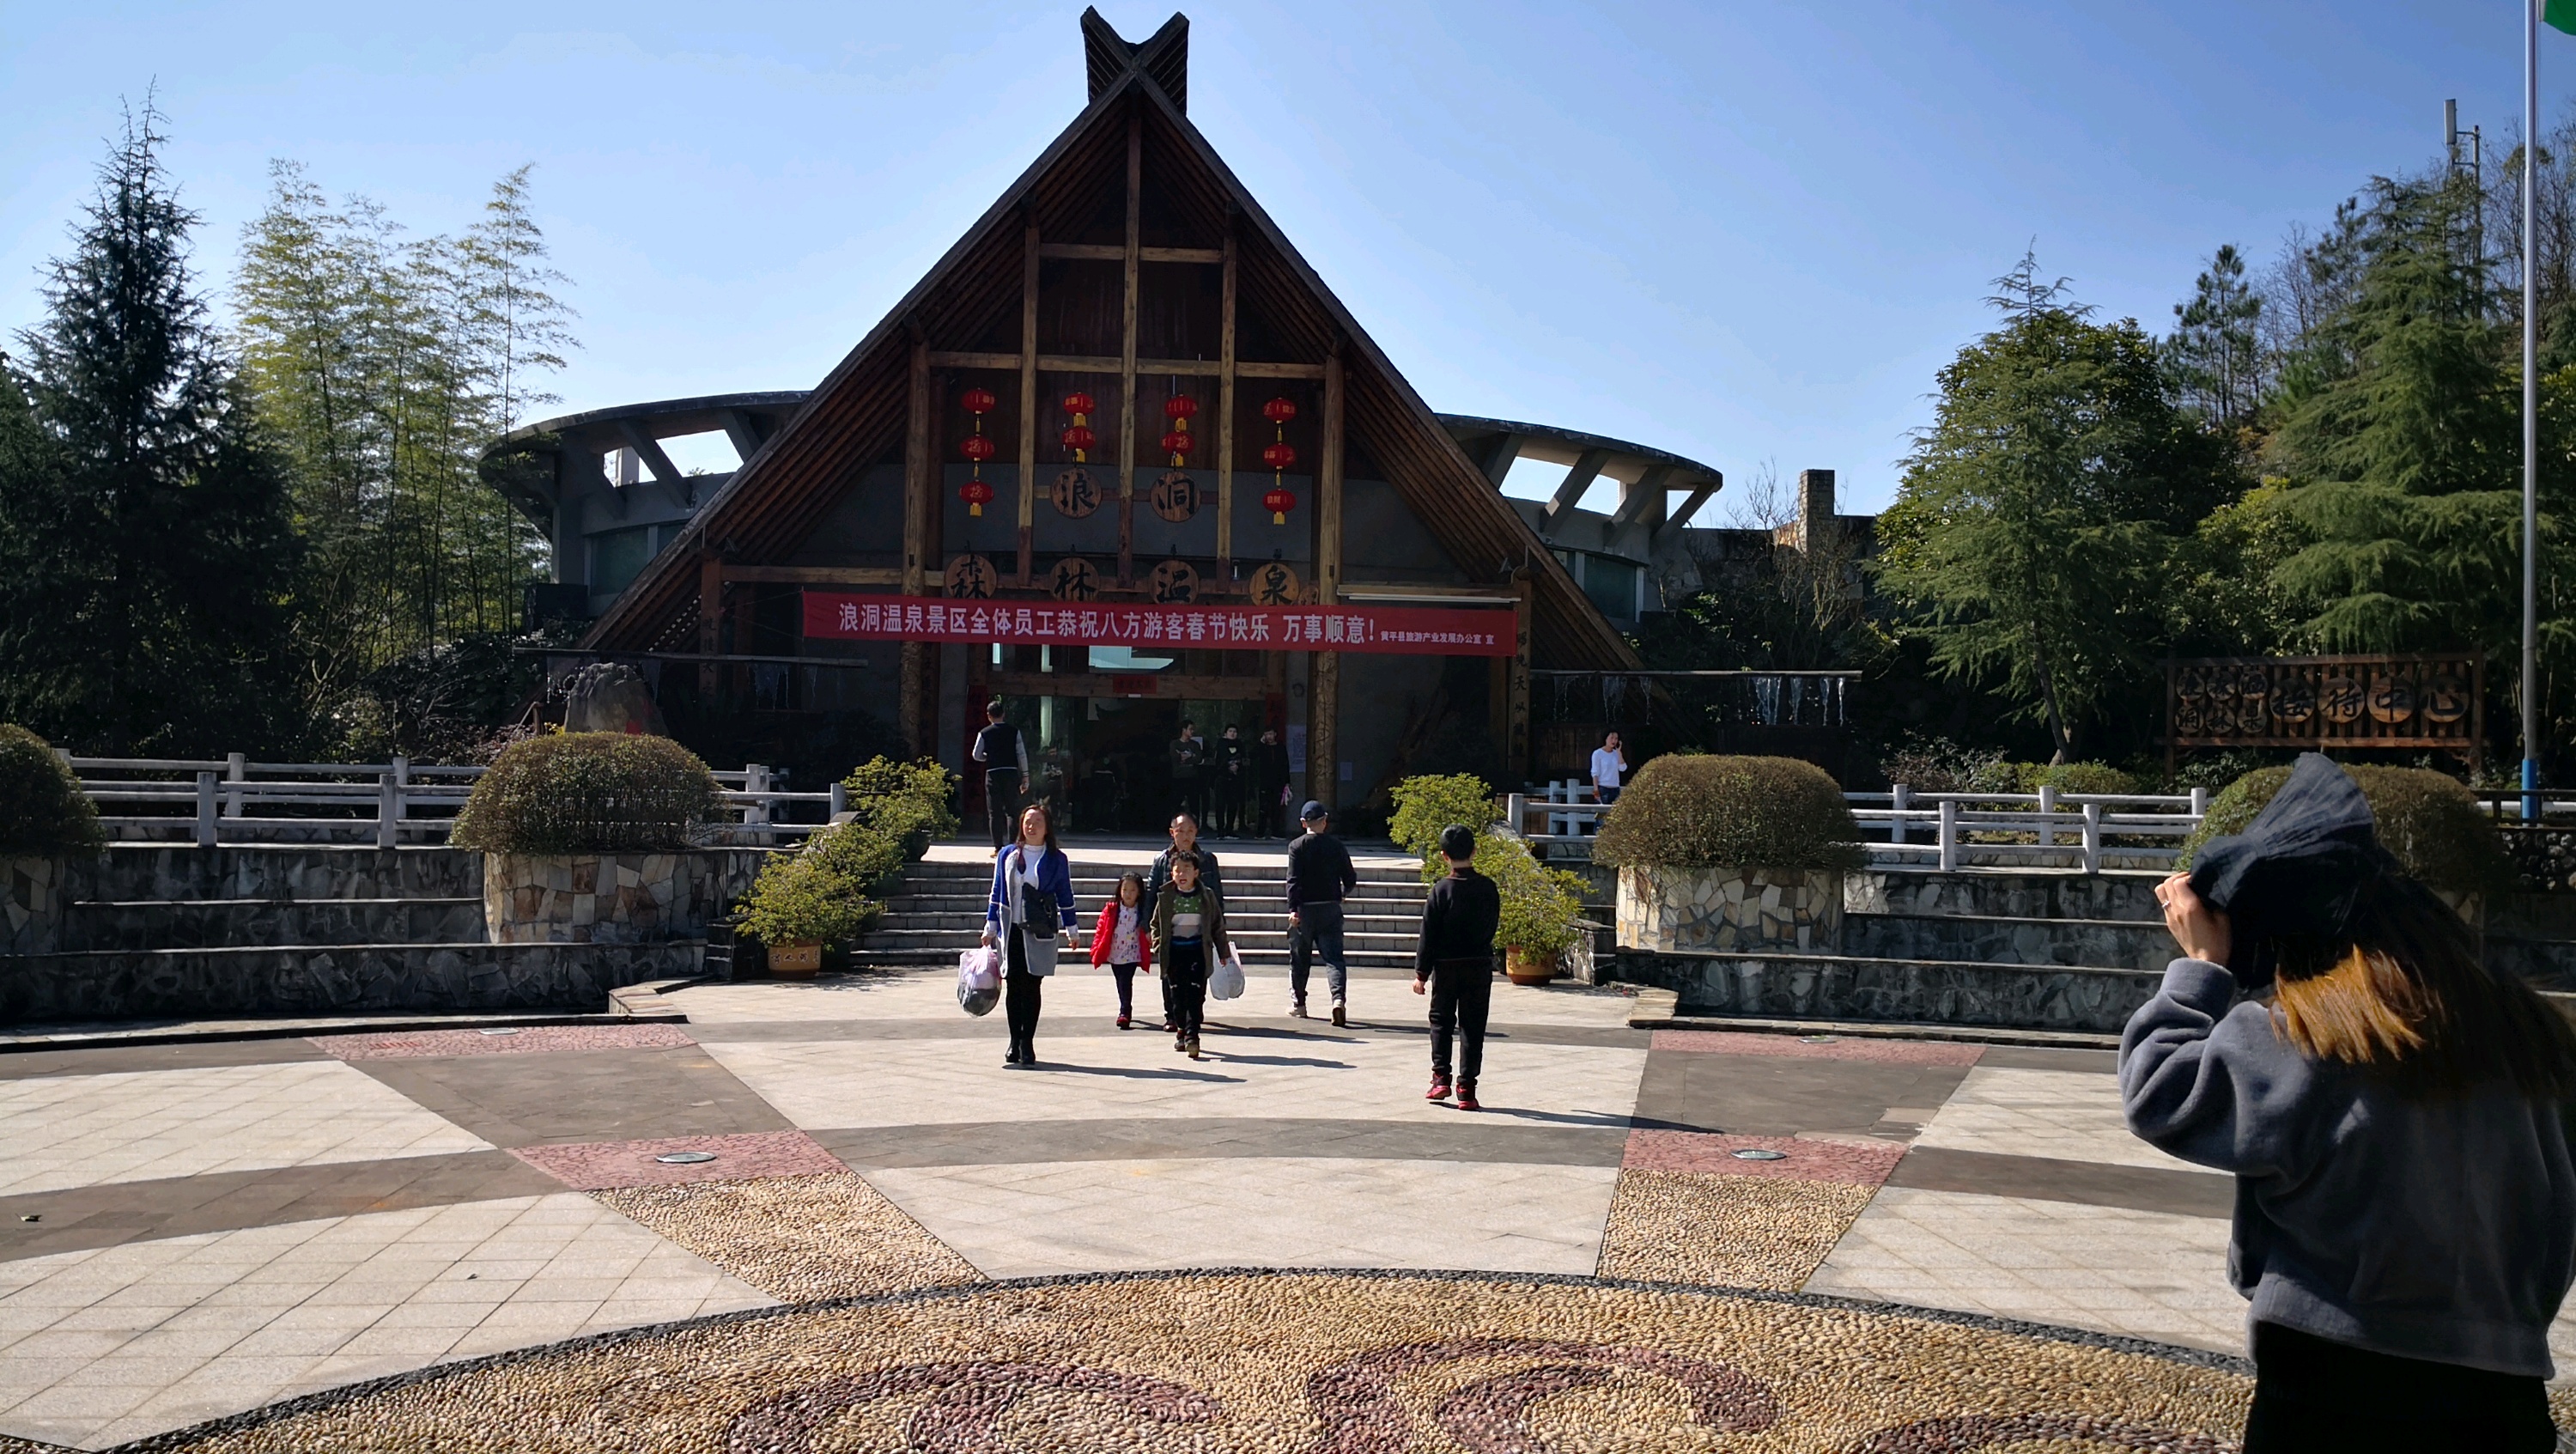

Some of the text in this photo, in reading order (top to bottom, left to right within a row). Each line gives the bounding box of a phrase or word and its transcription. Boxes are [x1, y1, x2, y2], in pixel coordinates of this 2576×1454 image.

[839, 602, 1270, 642] 浪洞温泉景区全体员工恭祝八方游客春节快乐
[2272, 676, 2465, 721] 接待中心
